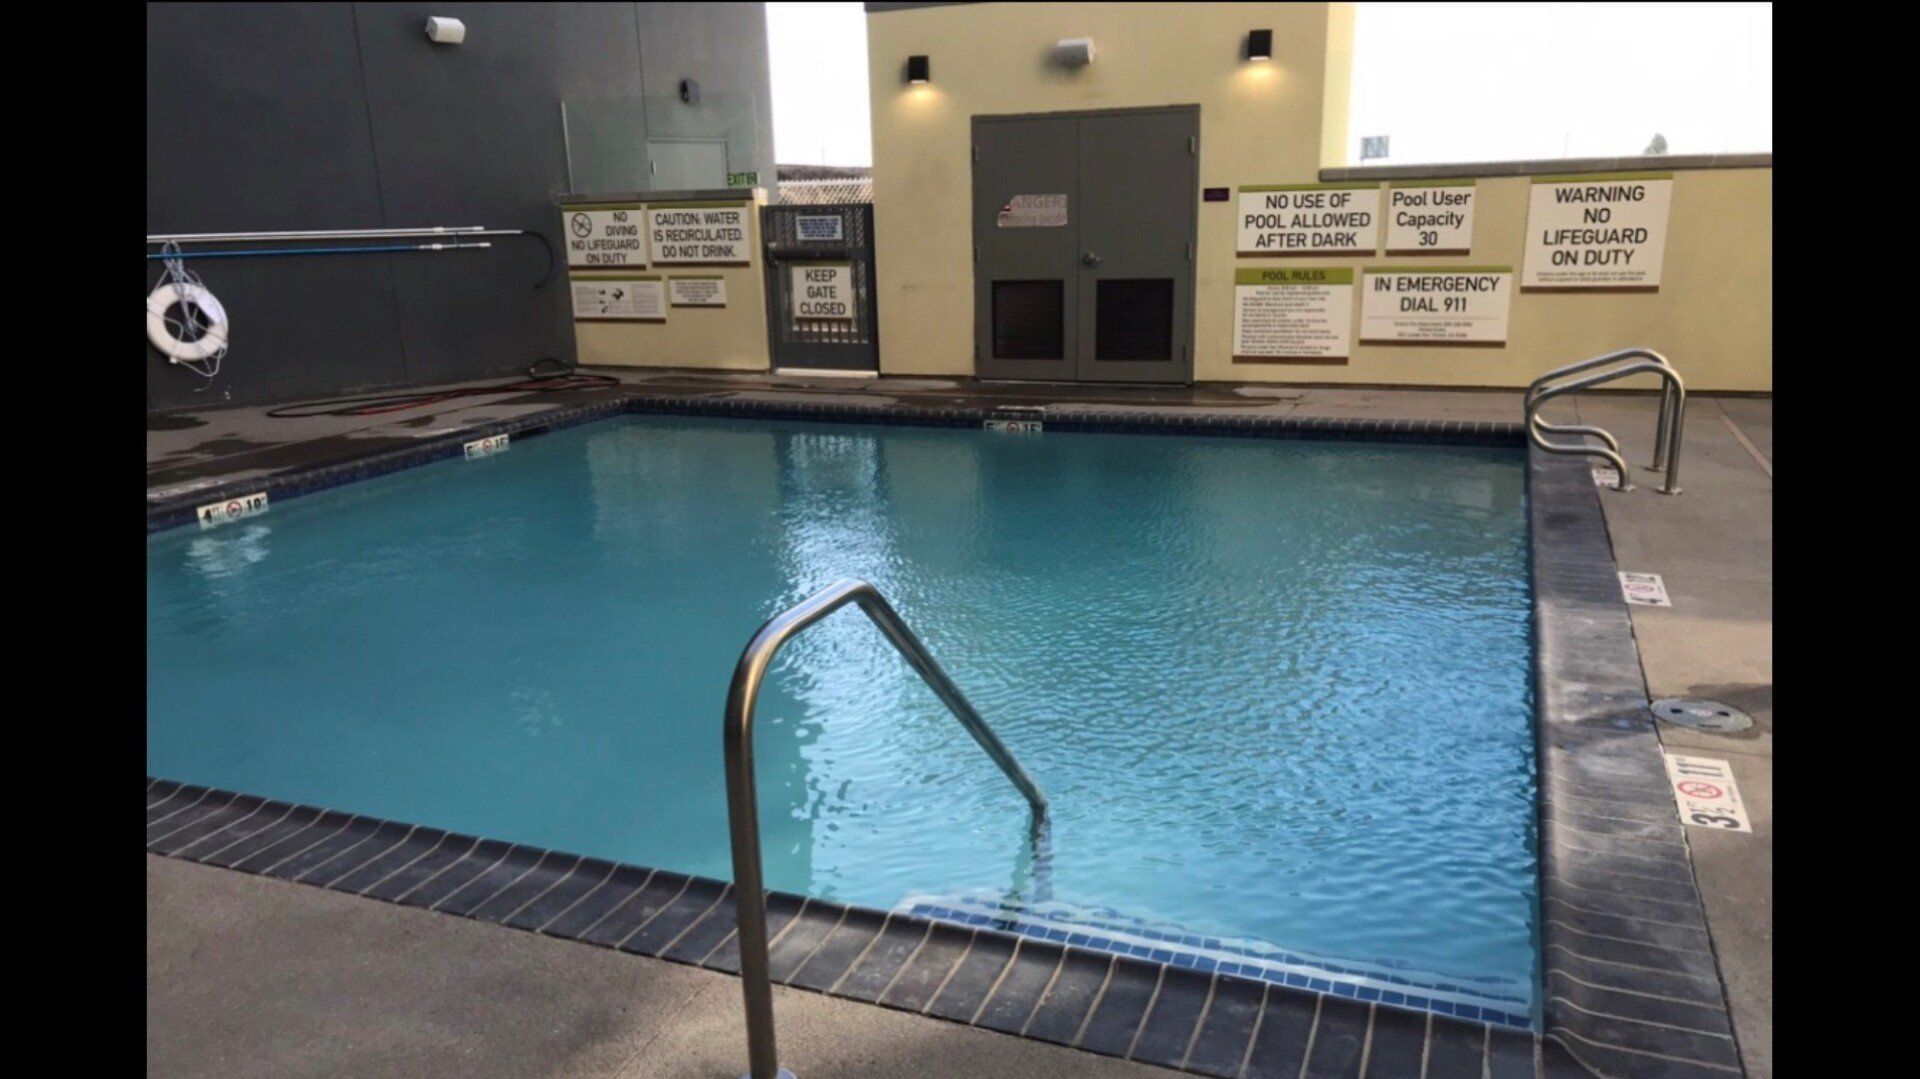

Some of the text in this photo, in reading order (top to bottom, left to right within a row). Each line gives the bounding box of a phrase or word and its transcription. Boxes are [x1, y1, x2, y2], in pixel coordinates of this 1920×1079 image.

[1265, 192, 1352, 209] NO USE OF
[1392, 190, 1472, 207] Pool User
[1555, 185, 1645, 203] WARNING
[613, 211, 627, 223] NO
[703, 211, 741, 225] WATER
[1245, 212, 1371, 229] POOL ALLOWED
[1396, 211, 1465, 230] Capacity
[1583, 207, 1611, 224] NO
[606, 225, 638, 236] DIVING
[653, 228, 743, 242] IS RECIRCULATED.
[1418, 230, 1438, 246] 30
[1543, 227, 1648, 246] LIFEGUARD
[572, 239, 640, 251] NO LIFEGUARD
[1255, 231, 1357, 248] AFTER DARK
[586, 253, 628, 264] ON DUTY
[662, 245, 737, 258] DO NOT DRINK.
[1551, 248, 1635, 266] ON DUTY
[805, 269, 837, 282] KEEP
[1262, 270, 1326, 281] POOL RULES
[1374, 276, 1500, 292] IN EMERGENCY
[806, 286, 837, 299] GATE
[799, 302, 846, 315] CLOSED
[1400, 297, 1467, 312] DIAL 911
